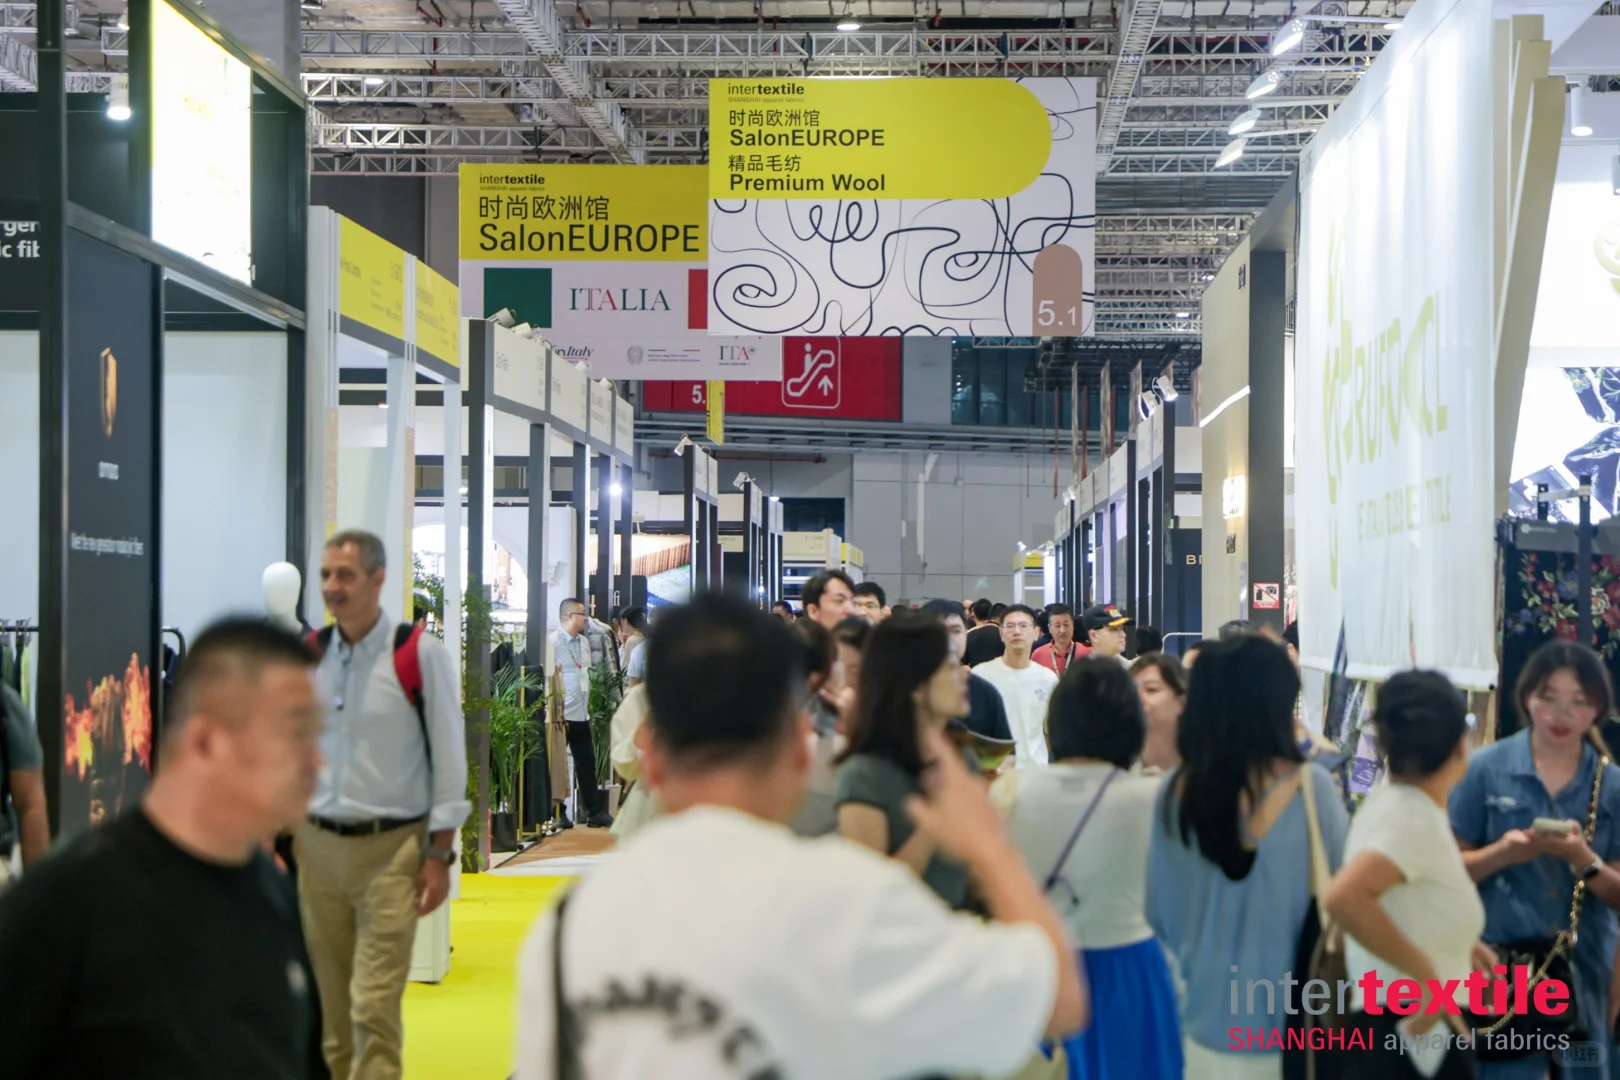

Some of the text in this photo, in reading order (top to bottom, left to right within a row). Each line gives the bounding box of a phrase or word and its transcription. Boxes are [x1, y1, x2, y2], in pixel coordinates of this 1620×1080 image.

[728, 83, 805, 95] intertextile
[729, 109, 820, 127] 时尚欧洲馆
[730, 129, 885, 146] SalonEUROPE
[728, 155, 801, 172] 精品毛纺
[479, 174, 545, 185] intertextile
[730, 174, 885, 191] Premium Wool
[479, 194, 609, 221] 时尚欧洲馆
[479, 223, 700, 252] SalonEUROPE
[569, 288, 671, 311] ITALIA
[1037, 300, 1076, 326] 5.1
